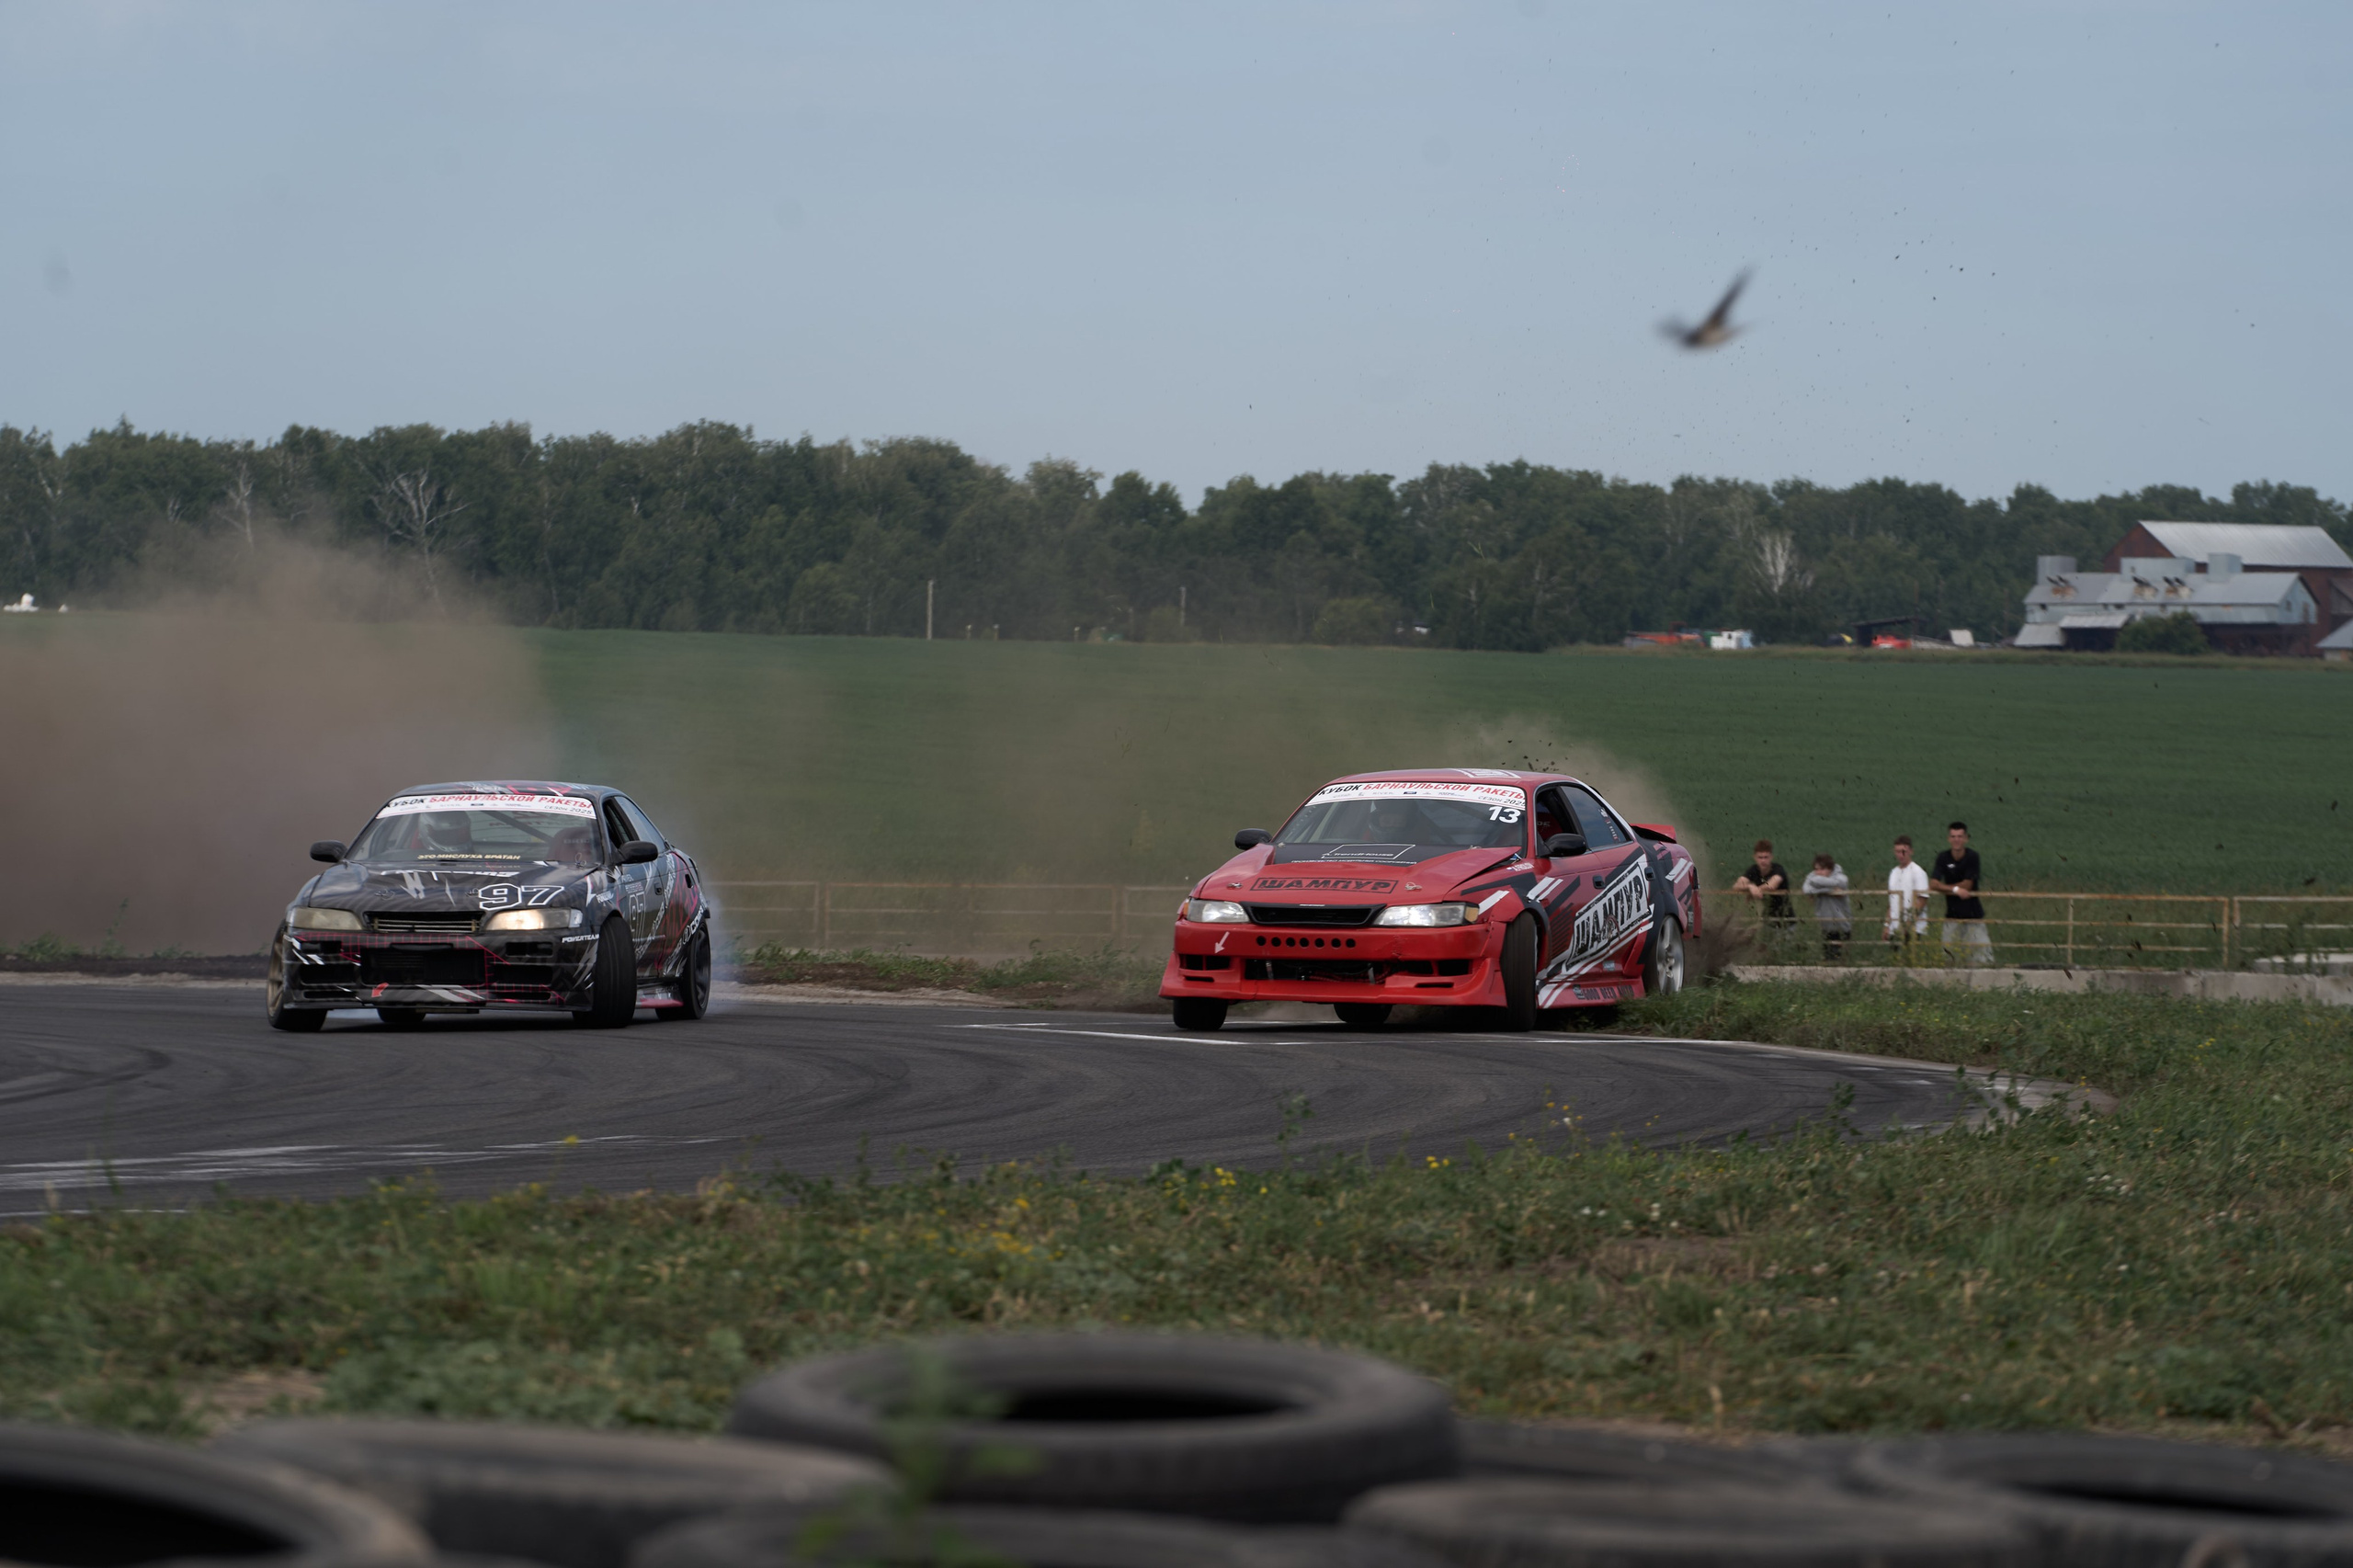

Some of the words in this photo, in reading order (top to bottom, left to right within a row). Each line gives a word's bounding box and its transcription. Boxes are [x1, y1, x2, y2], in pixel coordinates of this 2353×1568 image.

[1318, 784, 1362, 796] КУБОК
[1363, 782, 1472, 791] БАРНАУЛЬСКОЙ
[429, 794, 535, 802] БАРНАУЛЬСКОЙ
[539, 796, 593, 809] РАКЕТЫ
[1489, 806, 1521, 824] 13
[1257, 879, 1392, 891] ШАМПУР
[478, 882, 565, 911] 97
[1571, 874, 1643, 959] ШАМПУР
[562, 933, 599, 944] POWERTEAM
